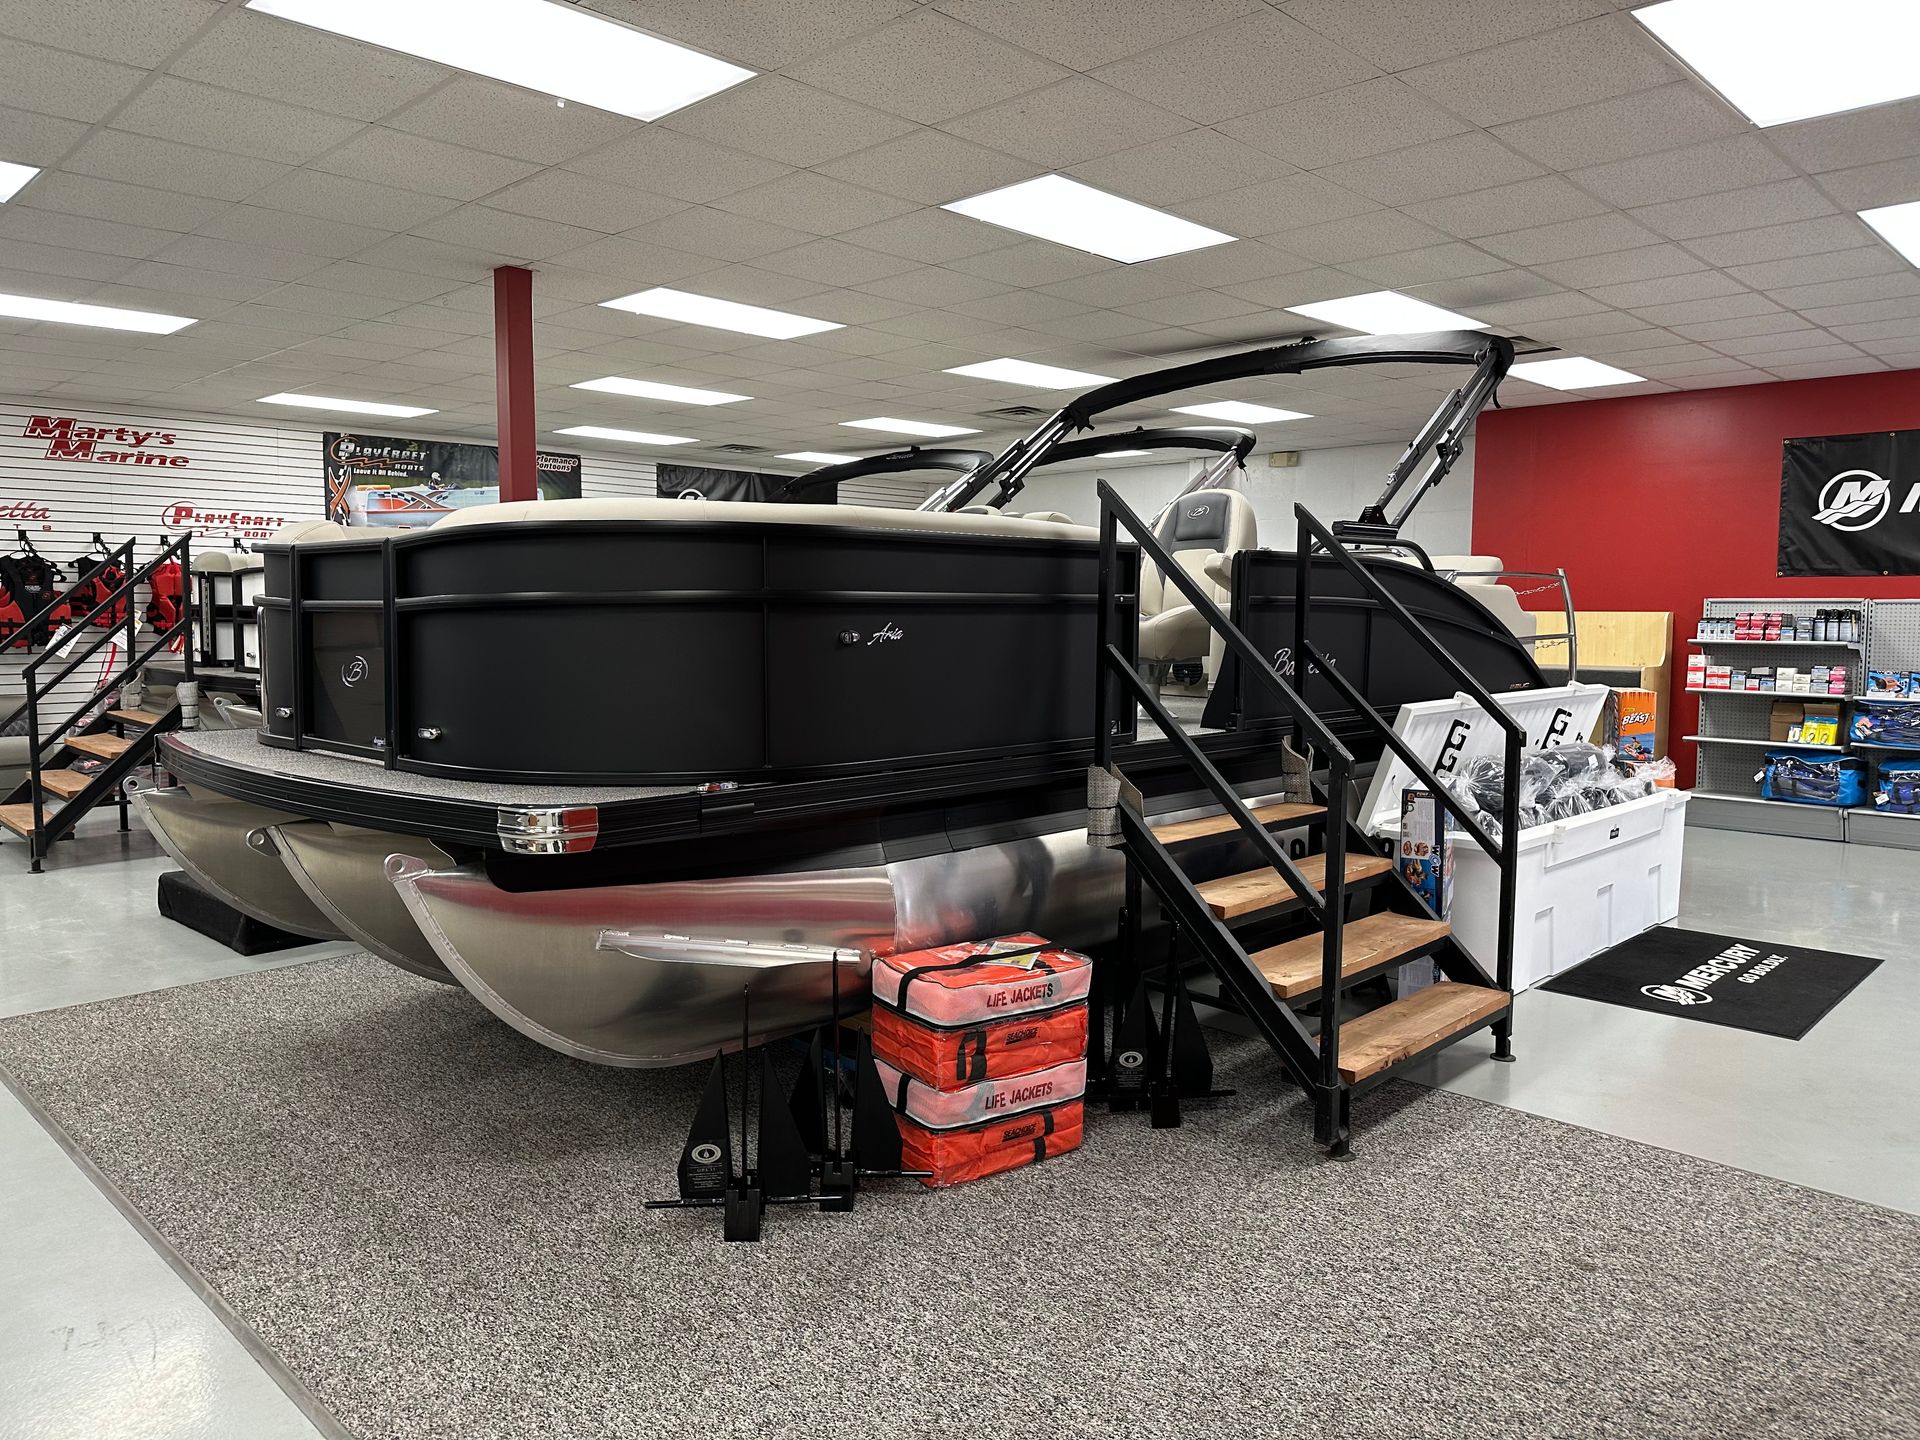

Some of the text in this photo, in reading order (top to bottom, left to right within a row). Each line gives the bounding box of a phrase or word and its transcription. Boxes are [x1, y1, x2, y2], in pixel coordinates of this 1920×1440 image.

[23, 415, 177, 448] Marty's
[44, 439, 190, 467] Marine
[536, 455, 578, 466] rformance
[867, 621, 904, 646] Aria
[1622, 712, 1650, 725] BEAST
[1430, 844, 1442, 878] WOW
[1675, 943, 1760, 990] MERCURY
[1737, 973, 1760, 983] GO
[986, 983, 1053, 1008] LIFE JACKETS
[985, 1081, 1053, 1110] LIFE JACKETS
